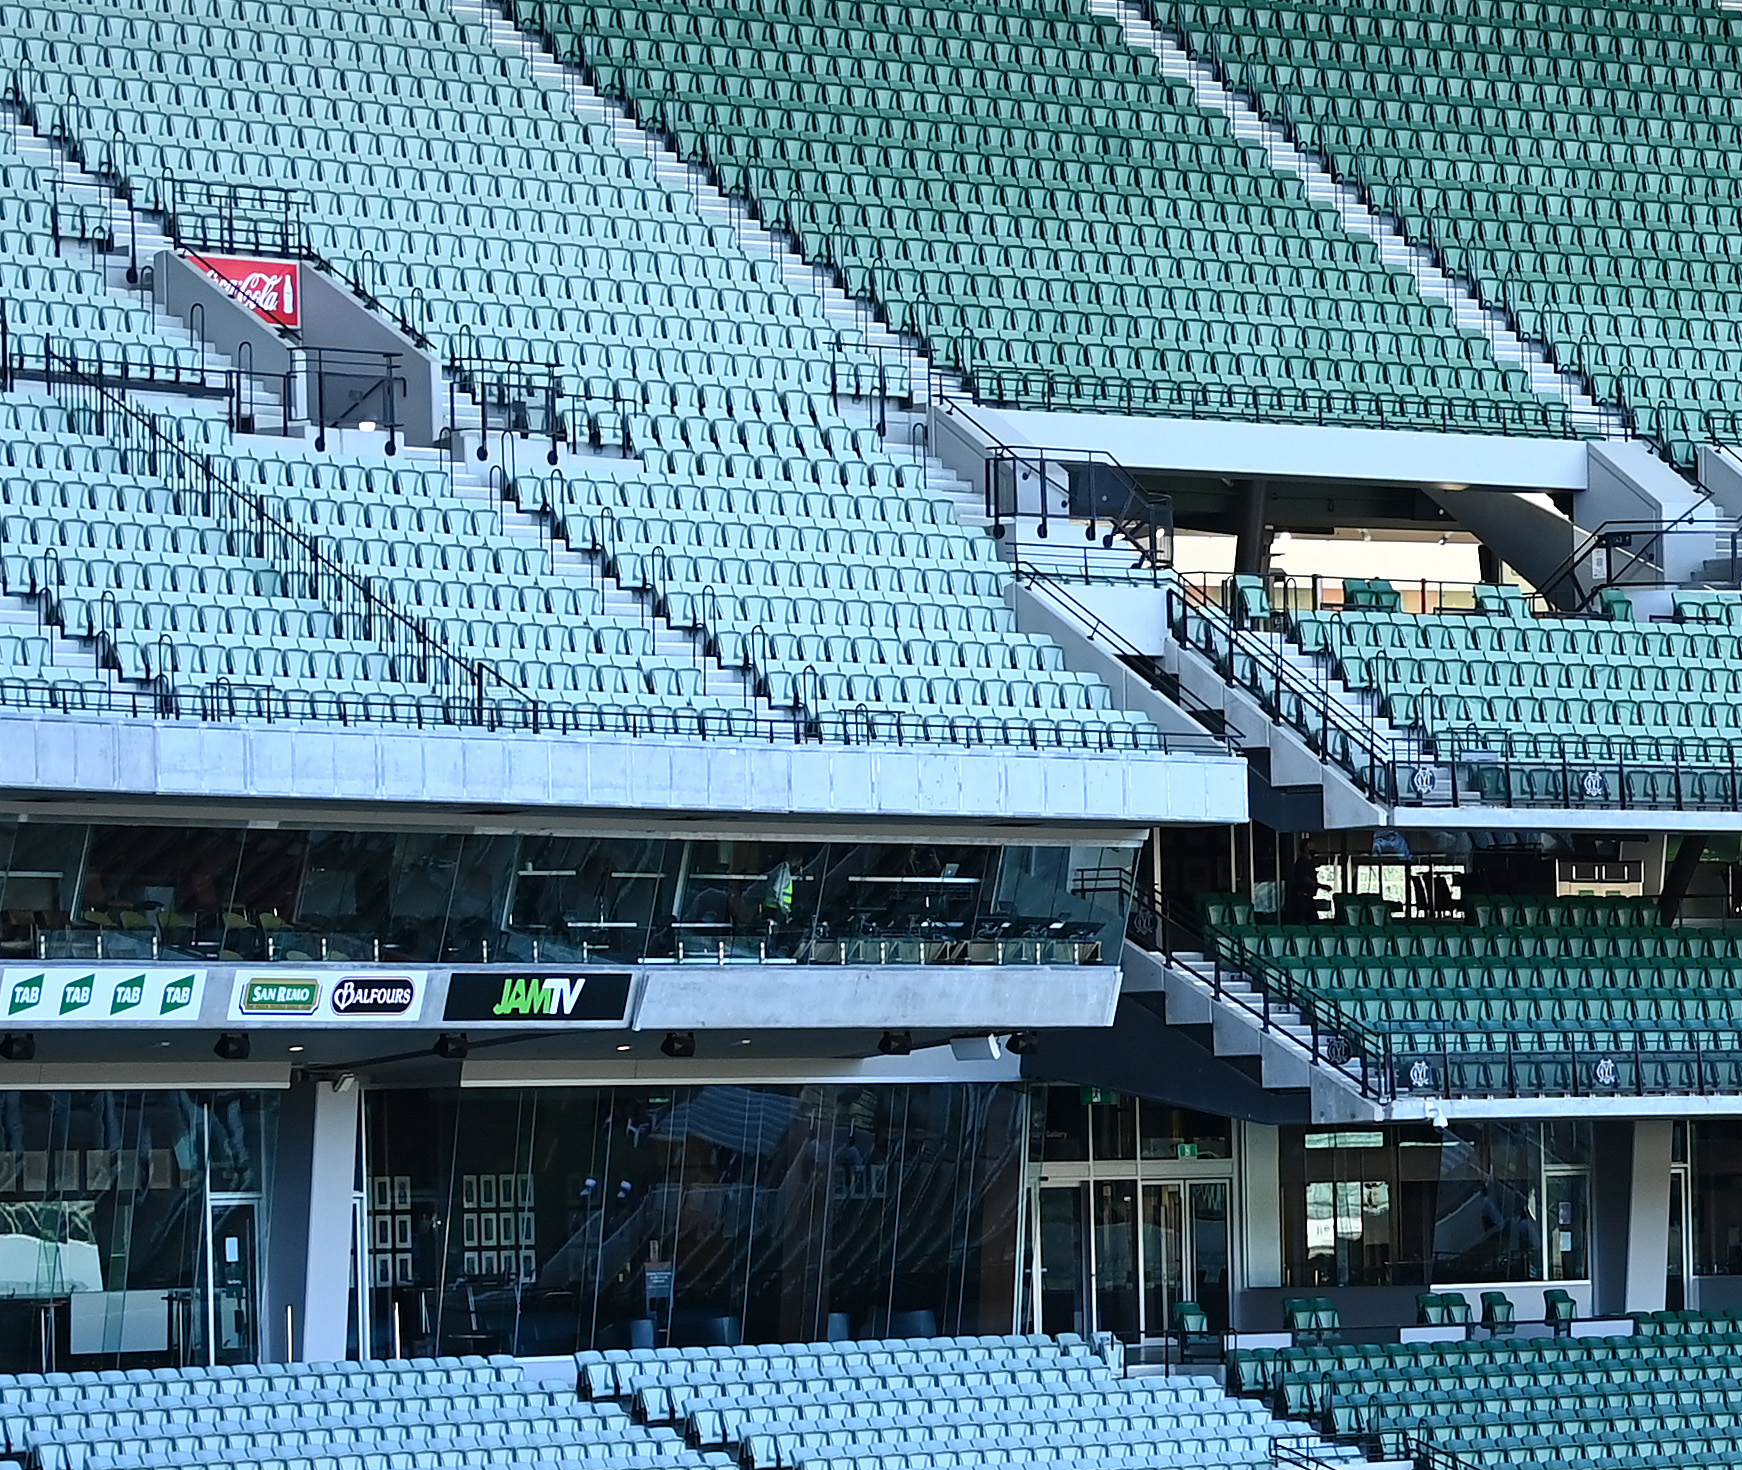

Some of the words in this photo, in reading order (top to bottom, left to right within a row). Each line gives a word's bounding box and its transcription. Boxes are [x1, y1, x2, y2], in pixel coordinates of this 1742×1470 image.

[14, 985, 39, 1003] TAB
[65, 985, 90, 1003] TAB
[116, 985, 140, 1003] TAB
[166, 985, 190, 1003] TAB
[252, 985, 277, 1002] SAN
[277, 985, 310, 1003] REMO
[334, 980, 411, 1010] BALFOURS
